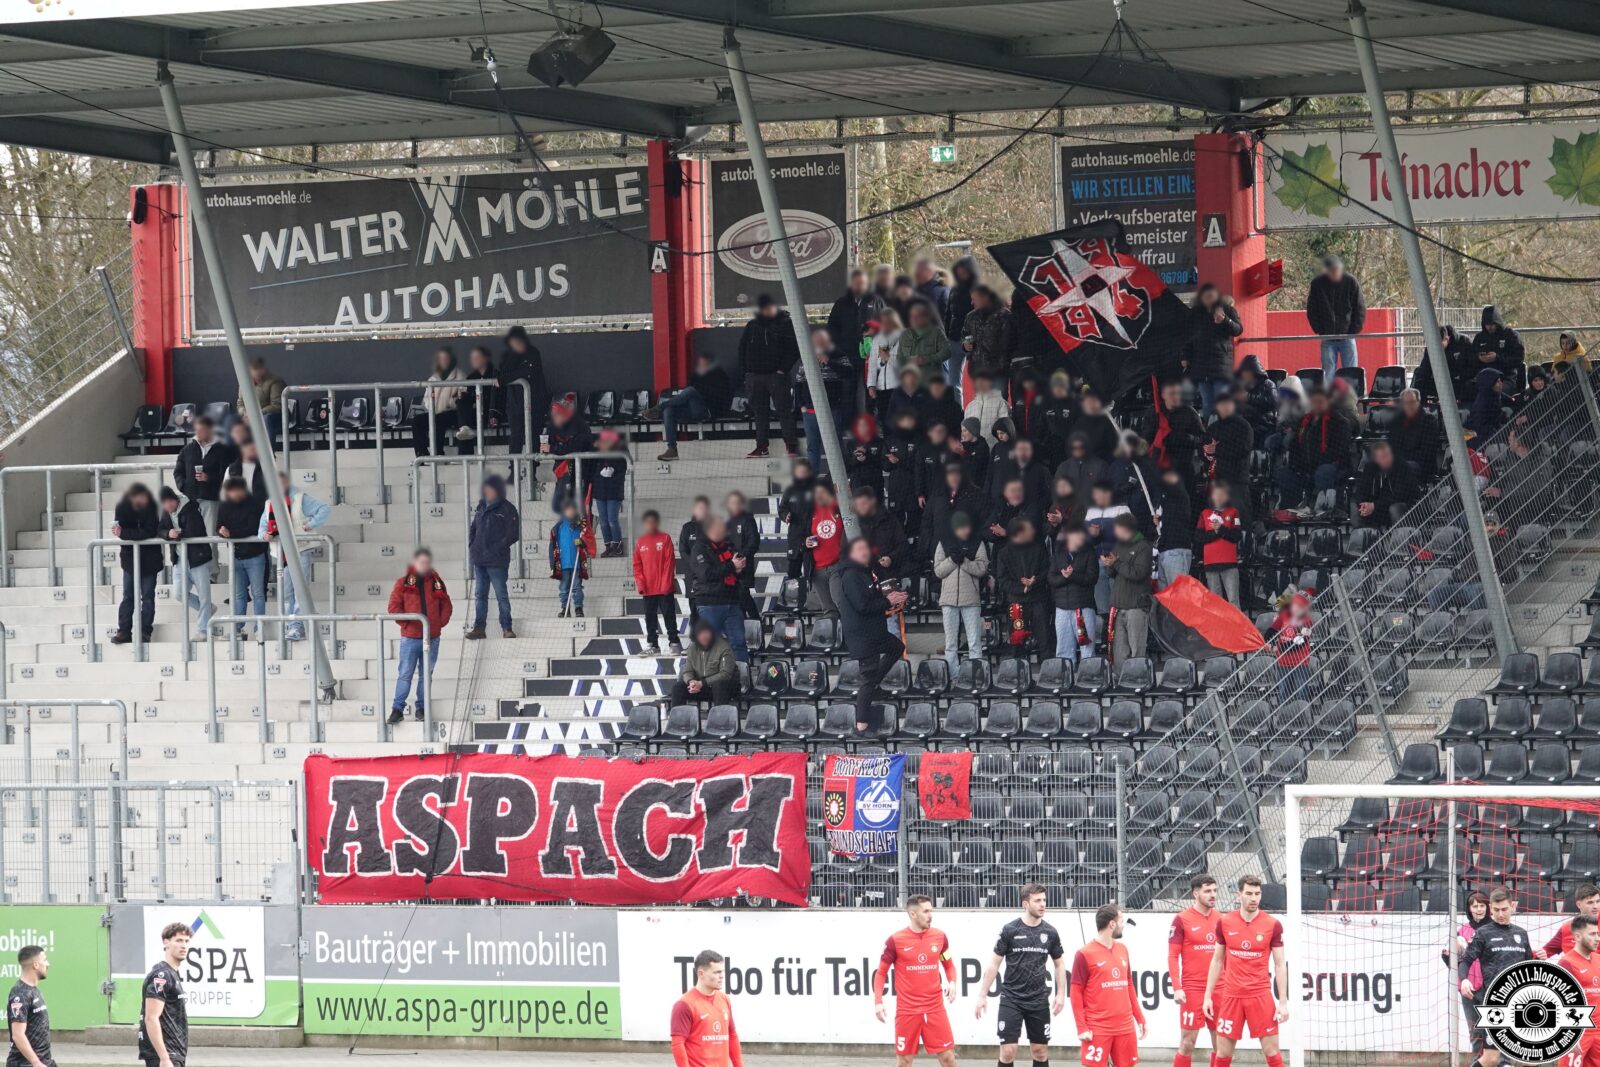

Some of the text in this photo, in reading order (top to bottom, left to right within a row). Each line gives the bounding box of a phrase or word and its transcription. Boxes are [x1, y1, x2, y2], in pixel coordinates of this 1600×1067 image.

[1071, 148, 1196, 168] autohaus-moehle.de
[721, 161, 841, 182] autohs-moehle.de
[205, 190, 312, 207] utohaus-moehle.de
[1071, 179, 1098, 199] WIR
[1102, 176, 1163, 198] STELLEN
[242, 171, 645, 274] WALTER MÖHLE
[1206, 217, 1223, 243] A
[1125, 228, 1188, 246] emeister
[651, 247, 667, 270] A
[1137, 248, 1176, 268] uffrau
[334, 263, 572, 328] AUTOHAUS
[862, 802, 893, 810] SV HORN
[322, 772, 795, 884] ASPACH
[315, 931, 437, 973] Bauträger
[467, 931, 607, 967] Immobilien
[179, 947, 254, 983] SPA
[674, 956, 763, 996] Tbo
[772, 956, 817, 996] für
[316, 990, 609, 1033] www.aspa-gruppe.de
[1182, 1011, 1194, 1027] 11
[1216, 1018, 1233, 1035] 25
[897, 1036, 906, 1052] 5
[1085, 1045, 1104, 1062] 23
